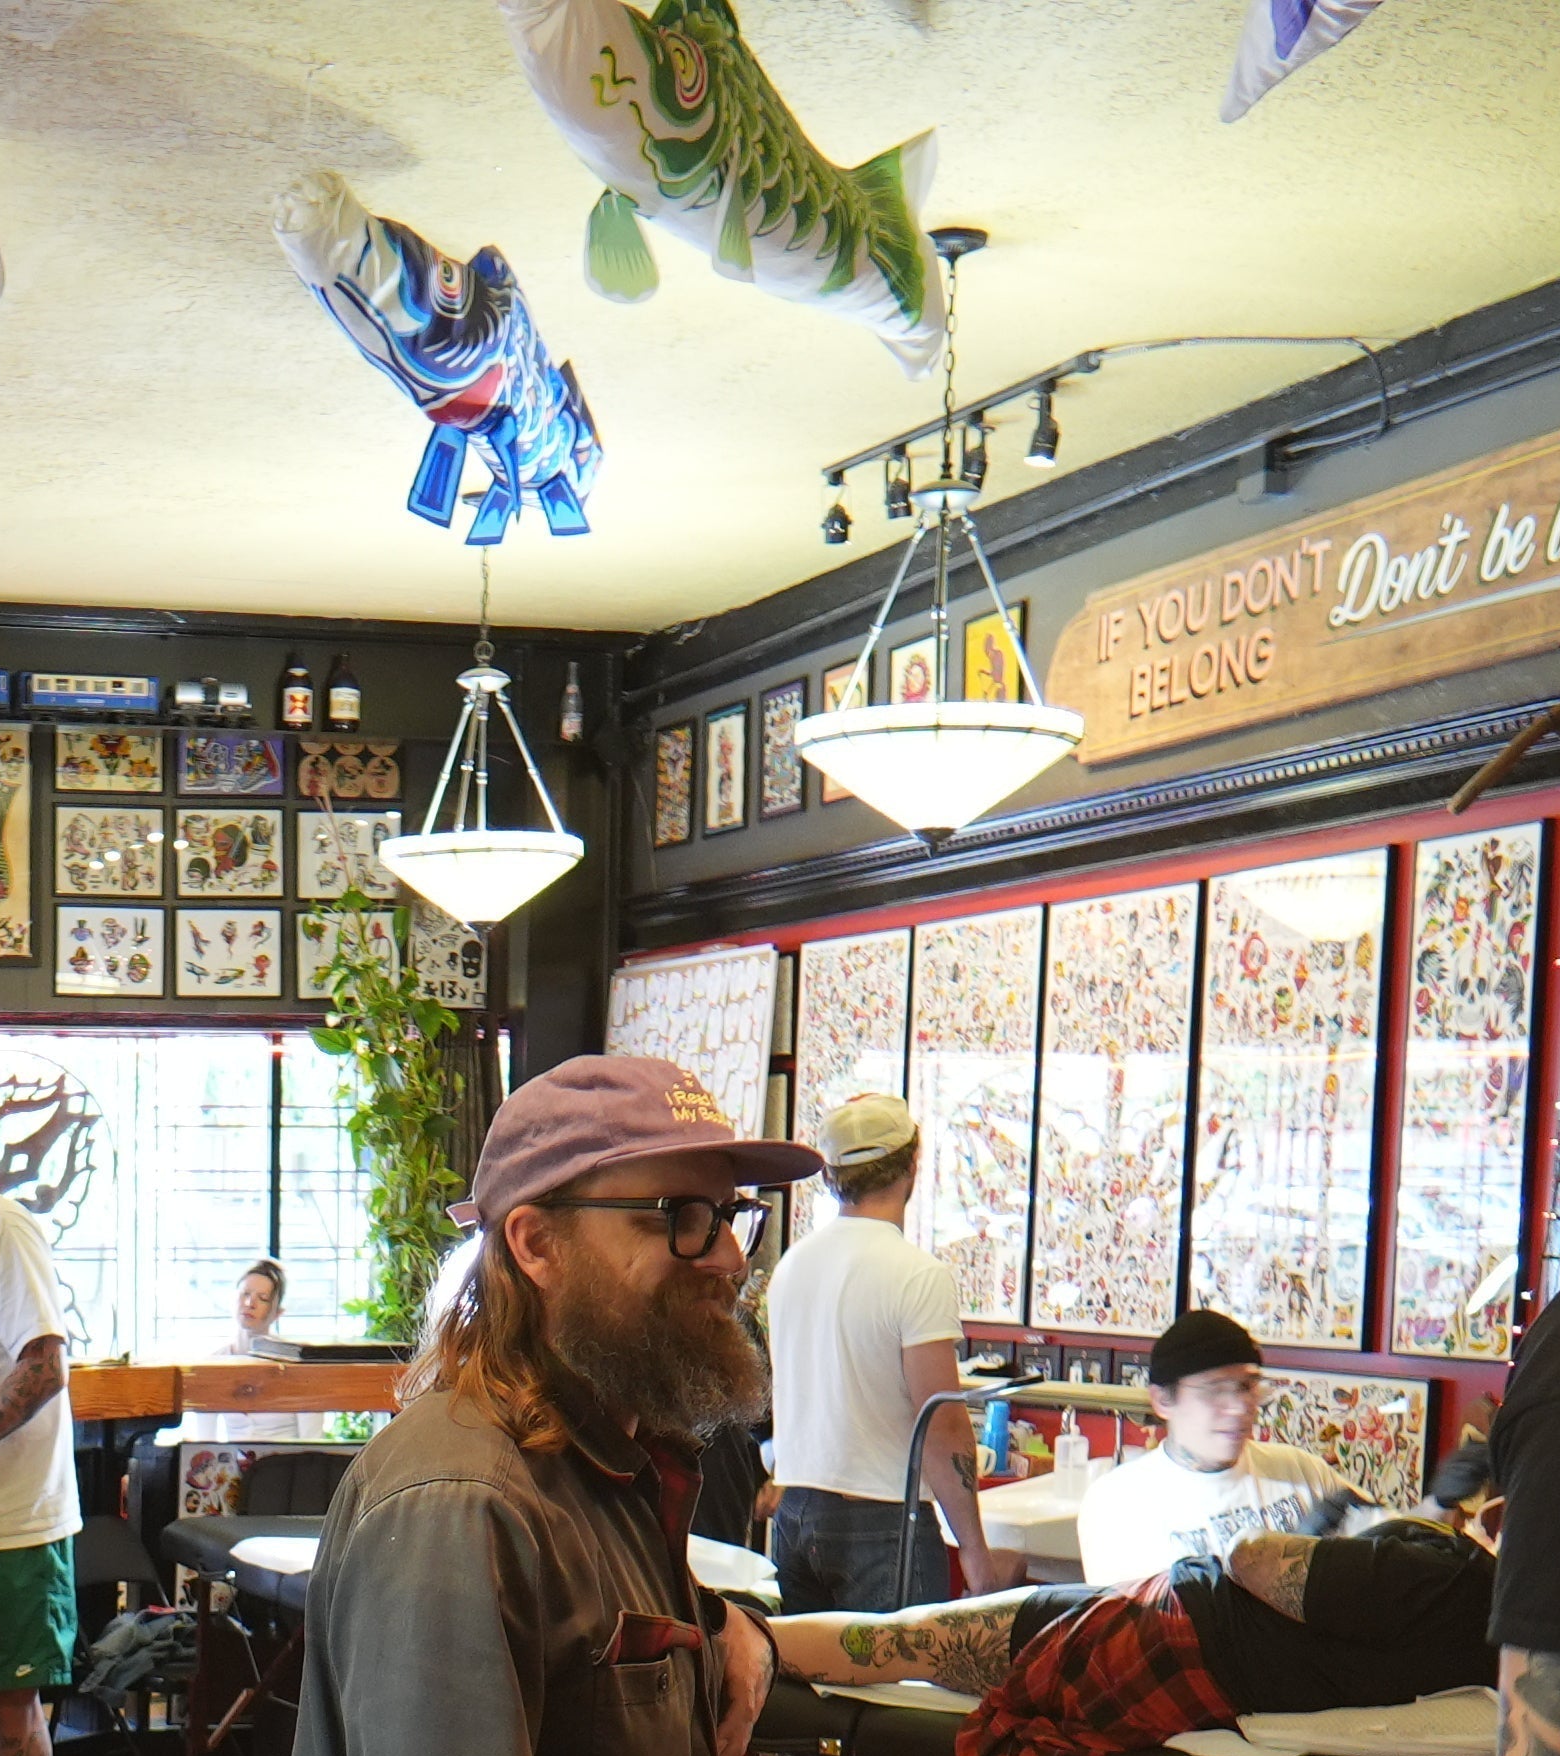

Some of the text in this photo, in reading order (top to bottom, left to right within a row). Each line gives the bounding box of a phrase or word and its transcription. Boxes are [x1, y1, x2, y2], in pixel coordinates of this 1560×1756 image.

[1097, 537, 1333, 663] IF YOU DON'T
[1327, 513, 1471, 628] Don't
[1480, 503, 1538, 583] be
[1130, 627, 1277, 718] BELONG
